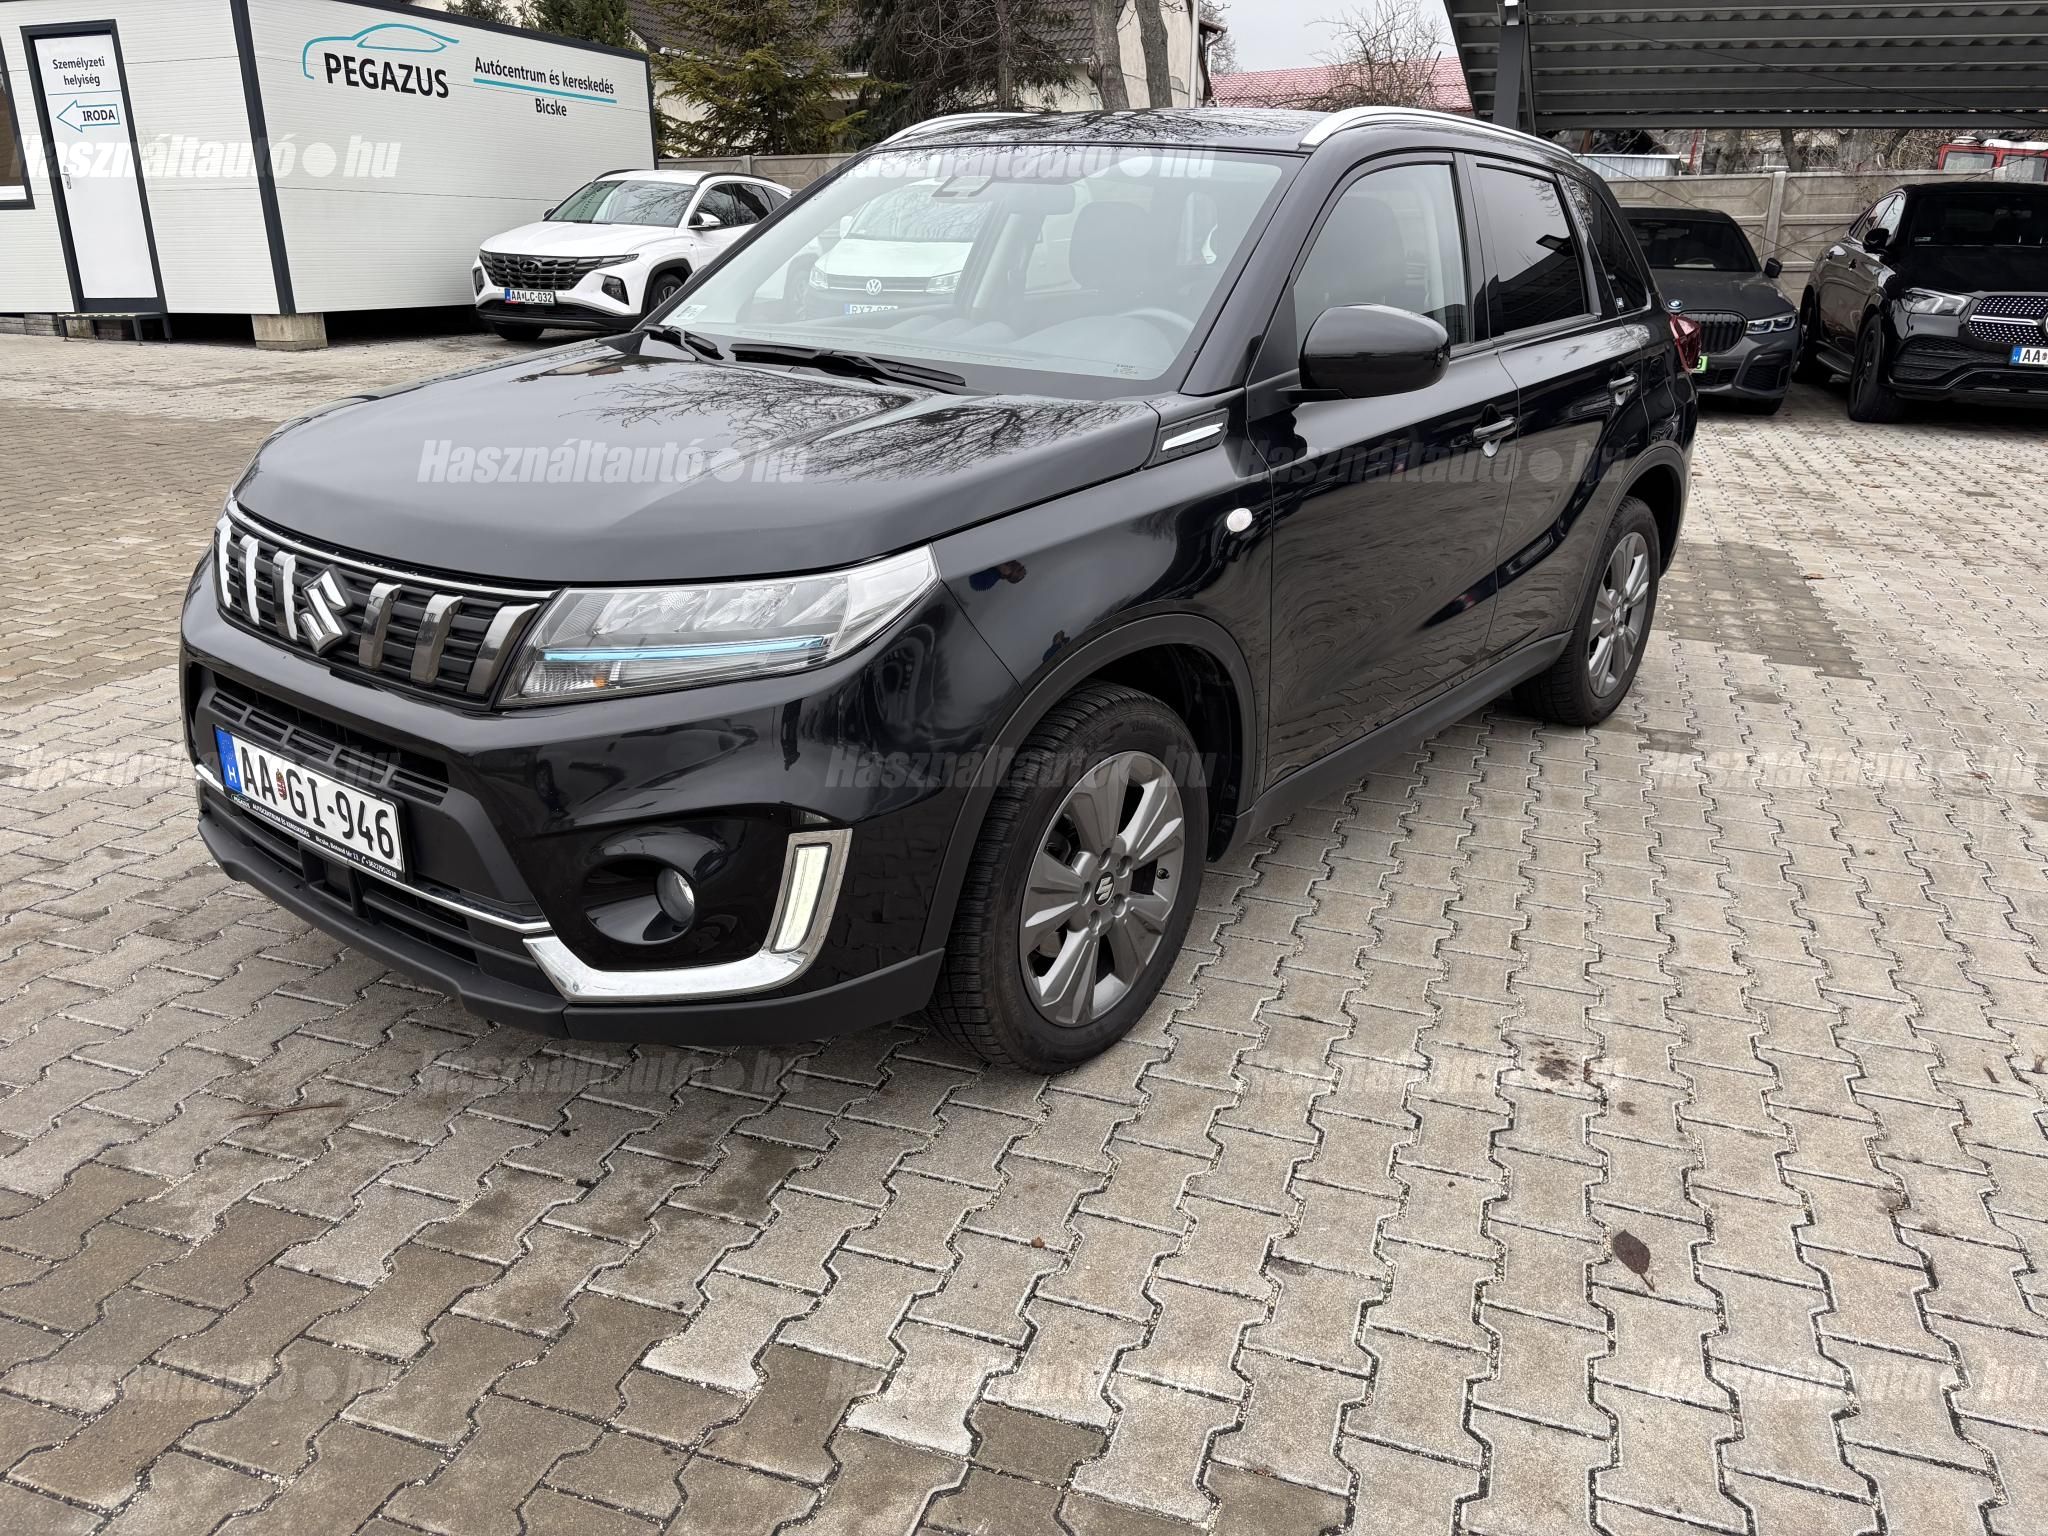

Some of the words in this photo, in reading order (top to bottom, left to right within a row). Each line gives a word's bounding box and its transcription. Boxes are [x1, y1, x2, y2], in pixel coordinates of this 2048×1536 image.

[52, 56, 105, 70] Személyzeti
[63, 74, 101, 87] helyiség
[324, 52, 449, 99] PEGAZUS
[474, 56, 547, 84] Autócentrum
[549, 67, 560, 86] és
[562, 71, 615, 95] kereskedés
[82, 109, 116, 122] IRODA
[535, 98, 567, 117] Bicske
